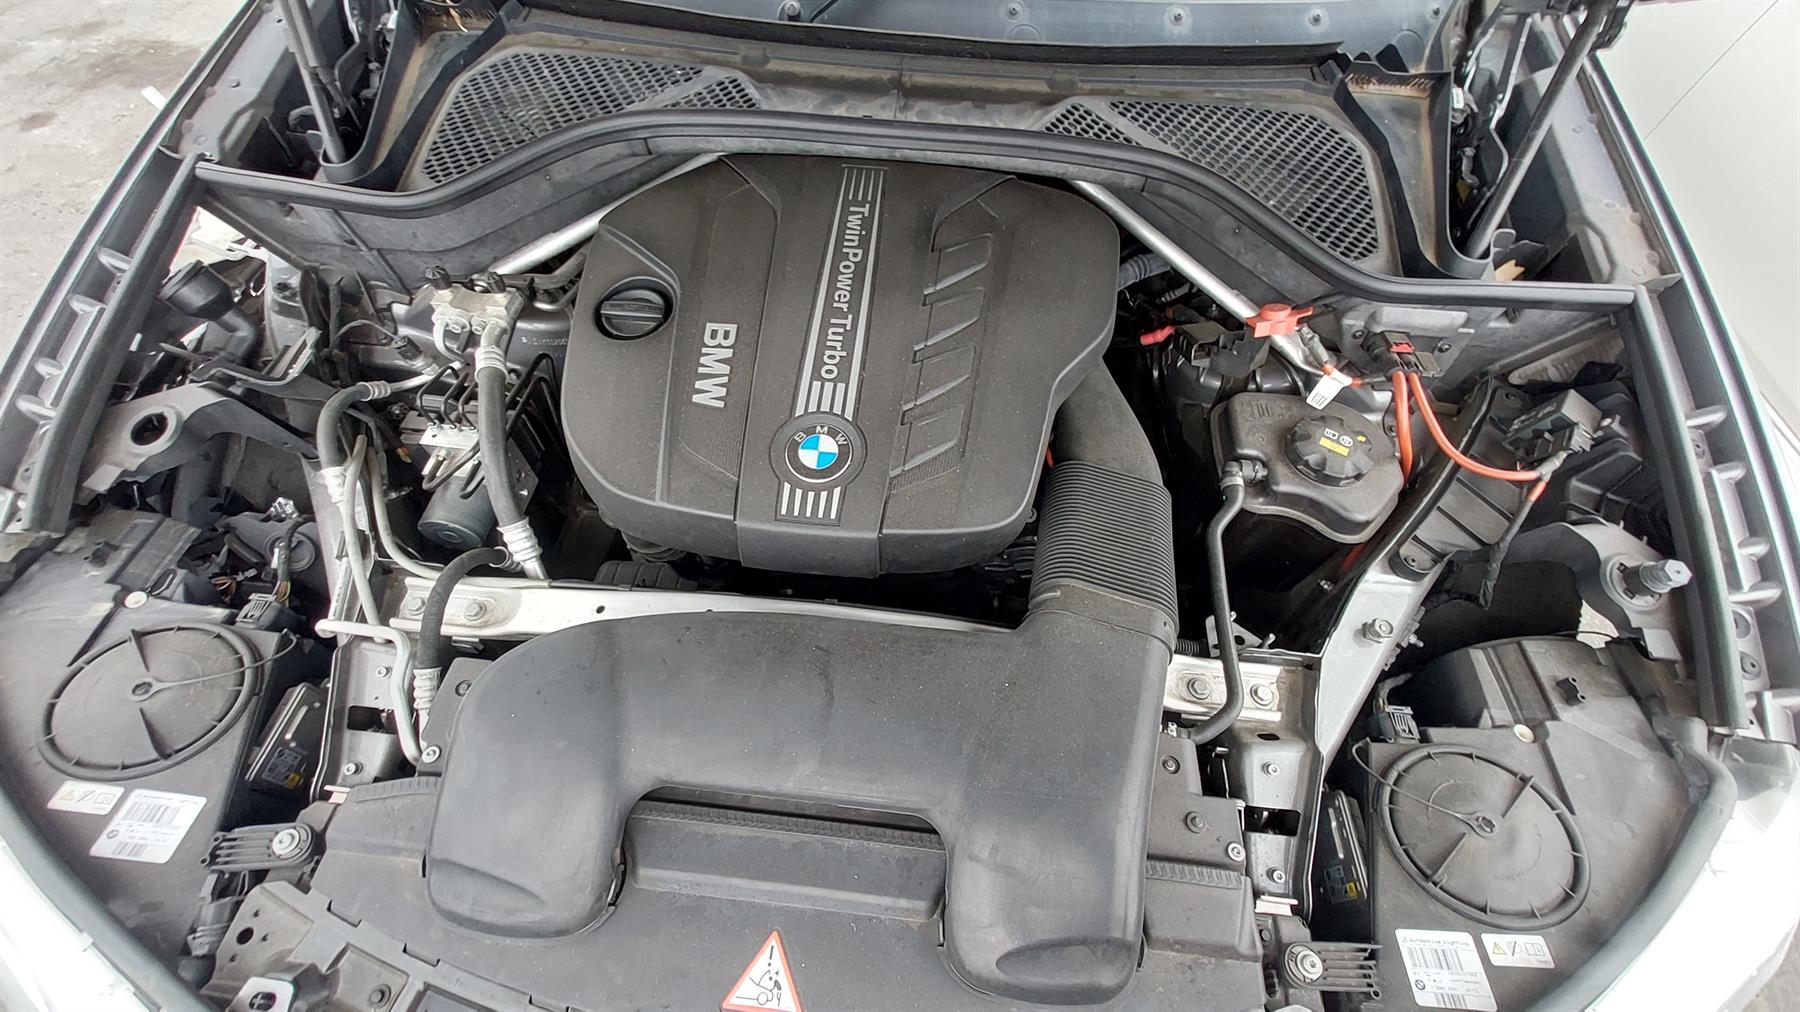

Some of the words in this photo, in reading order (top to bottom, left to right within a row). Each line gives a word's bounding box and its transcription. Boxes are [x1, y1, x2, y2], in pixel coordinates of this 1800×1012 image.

[833, 203, 870, 312] TwinPower
[691, 322, 738, 408] BMW
[820, 314, 853, 379] Turbo
[794, 425, 848, 445] BMW
